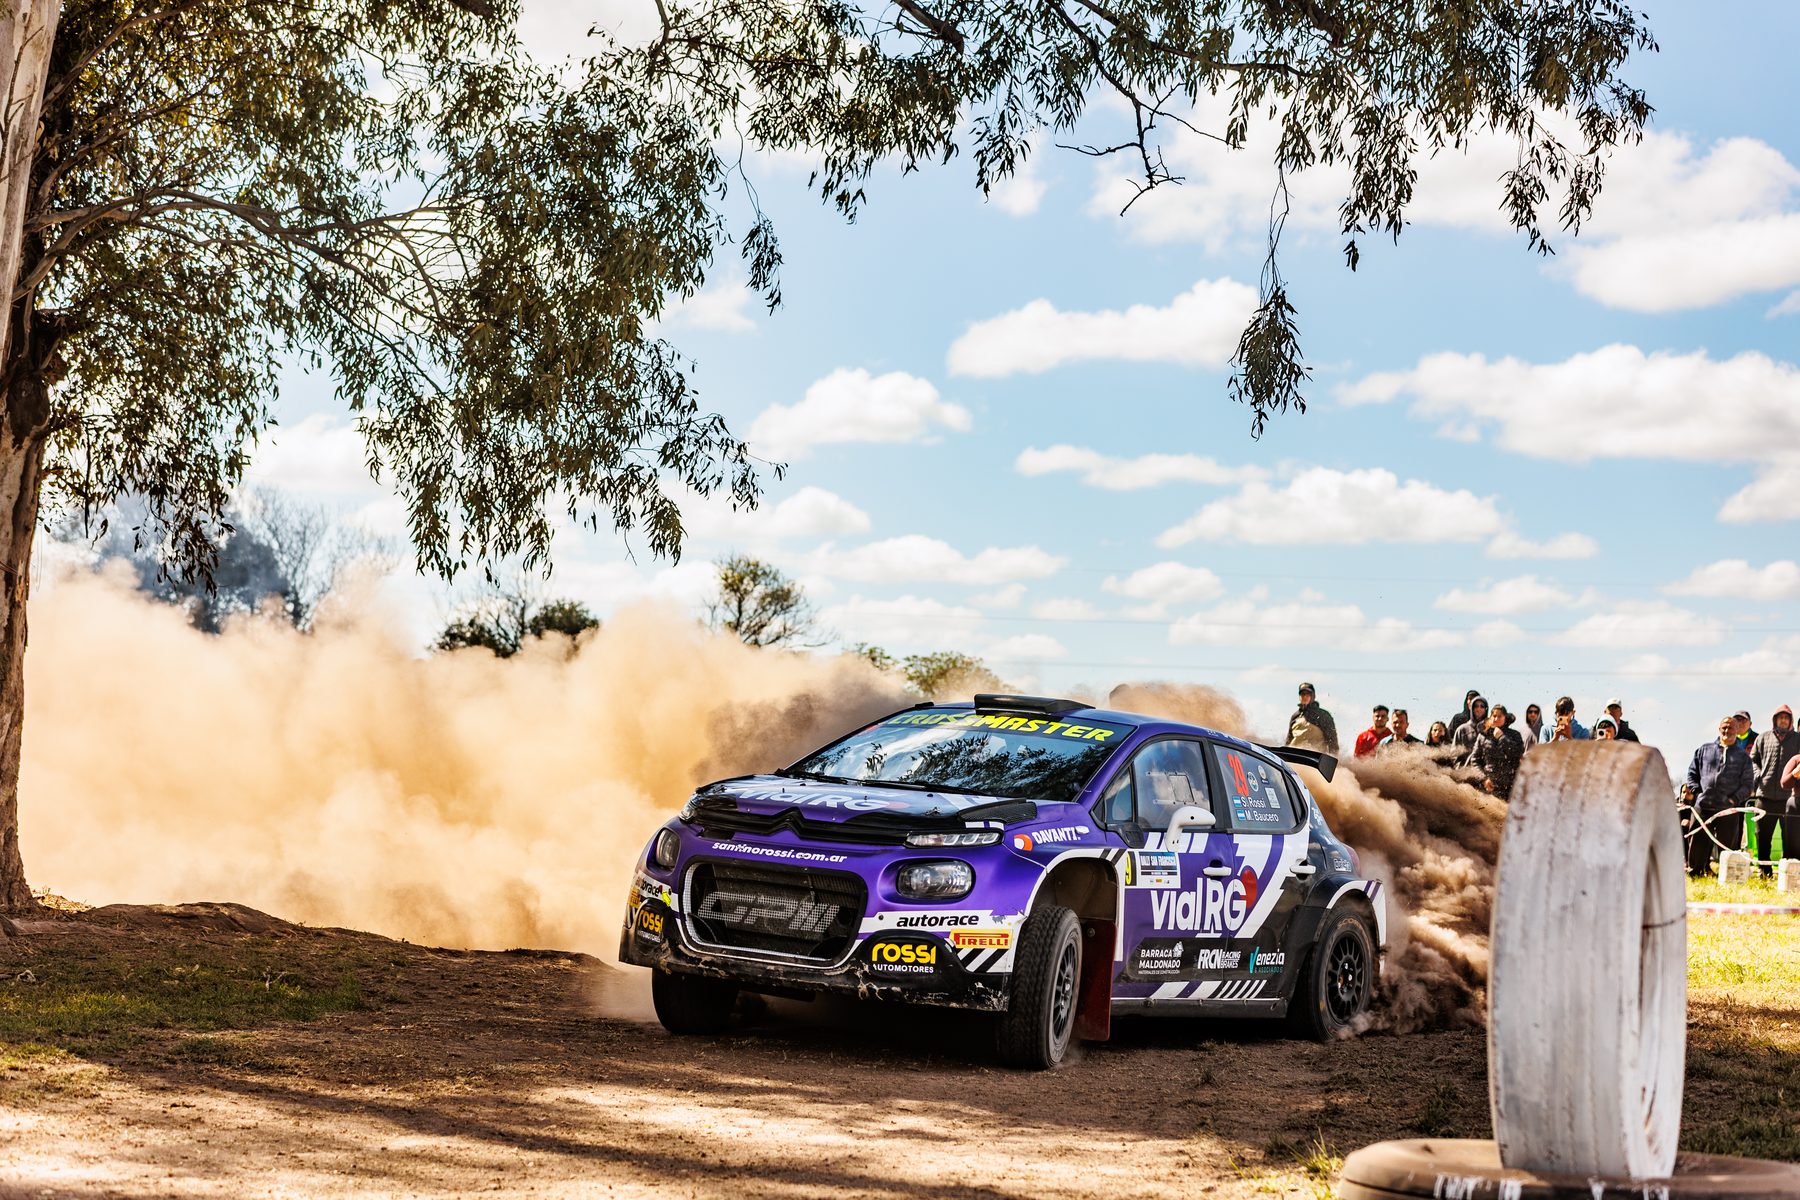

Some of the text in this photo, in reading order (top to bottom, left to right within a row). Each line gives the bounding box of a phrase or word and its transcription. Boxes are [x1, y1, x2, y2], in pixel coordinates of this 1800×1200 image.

[887, 713, 1115, 742] CROSSMASTER
[1227, 752, 1249, 797] 29
[1248, 797, 1266, 808] Rossi
[712, 841, 847, 863] santinorossi.com.ar
[896, 914, 979, 927] autorace
[953, 932, 1009, 947] PIRELLI
[1140, 949, 1173, 958] BARRACA
[1249, 946, 1285, 974] Venezia
[1138, 959, 1181, 969] MALDONADO
